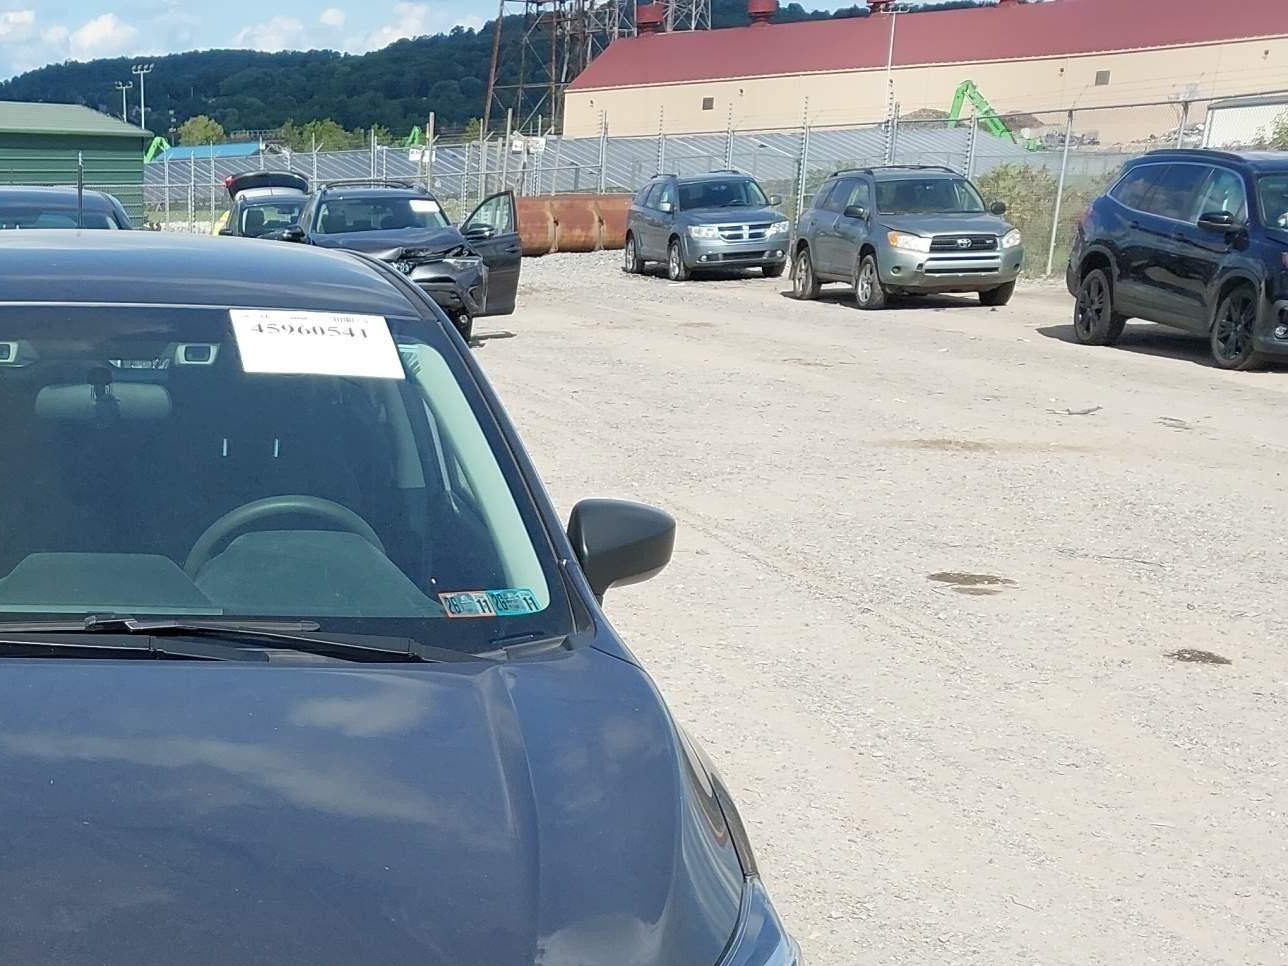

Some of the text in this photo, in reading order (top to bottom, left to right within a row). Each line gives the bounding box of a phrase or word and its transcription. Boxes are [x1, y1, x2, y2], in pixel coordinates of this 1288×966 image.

[252, 323, 369, 339] 45960541
[476, 598, 492, 613] 11
[522, 596, 539, 611] 11
